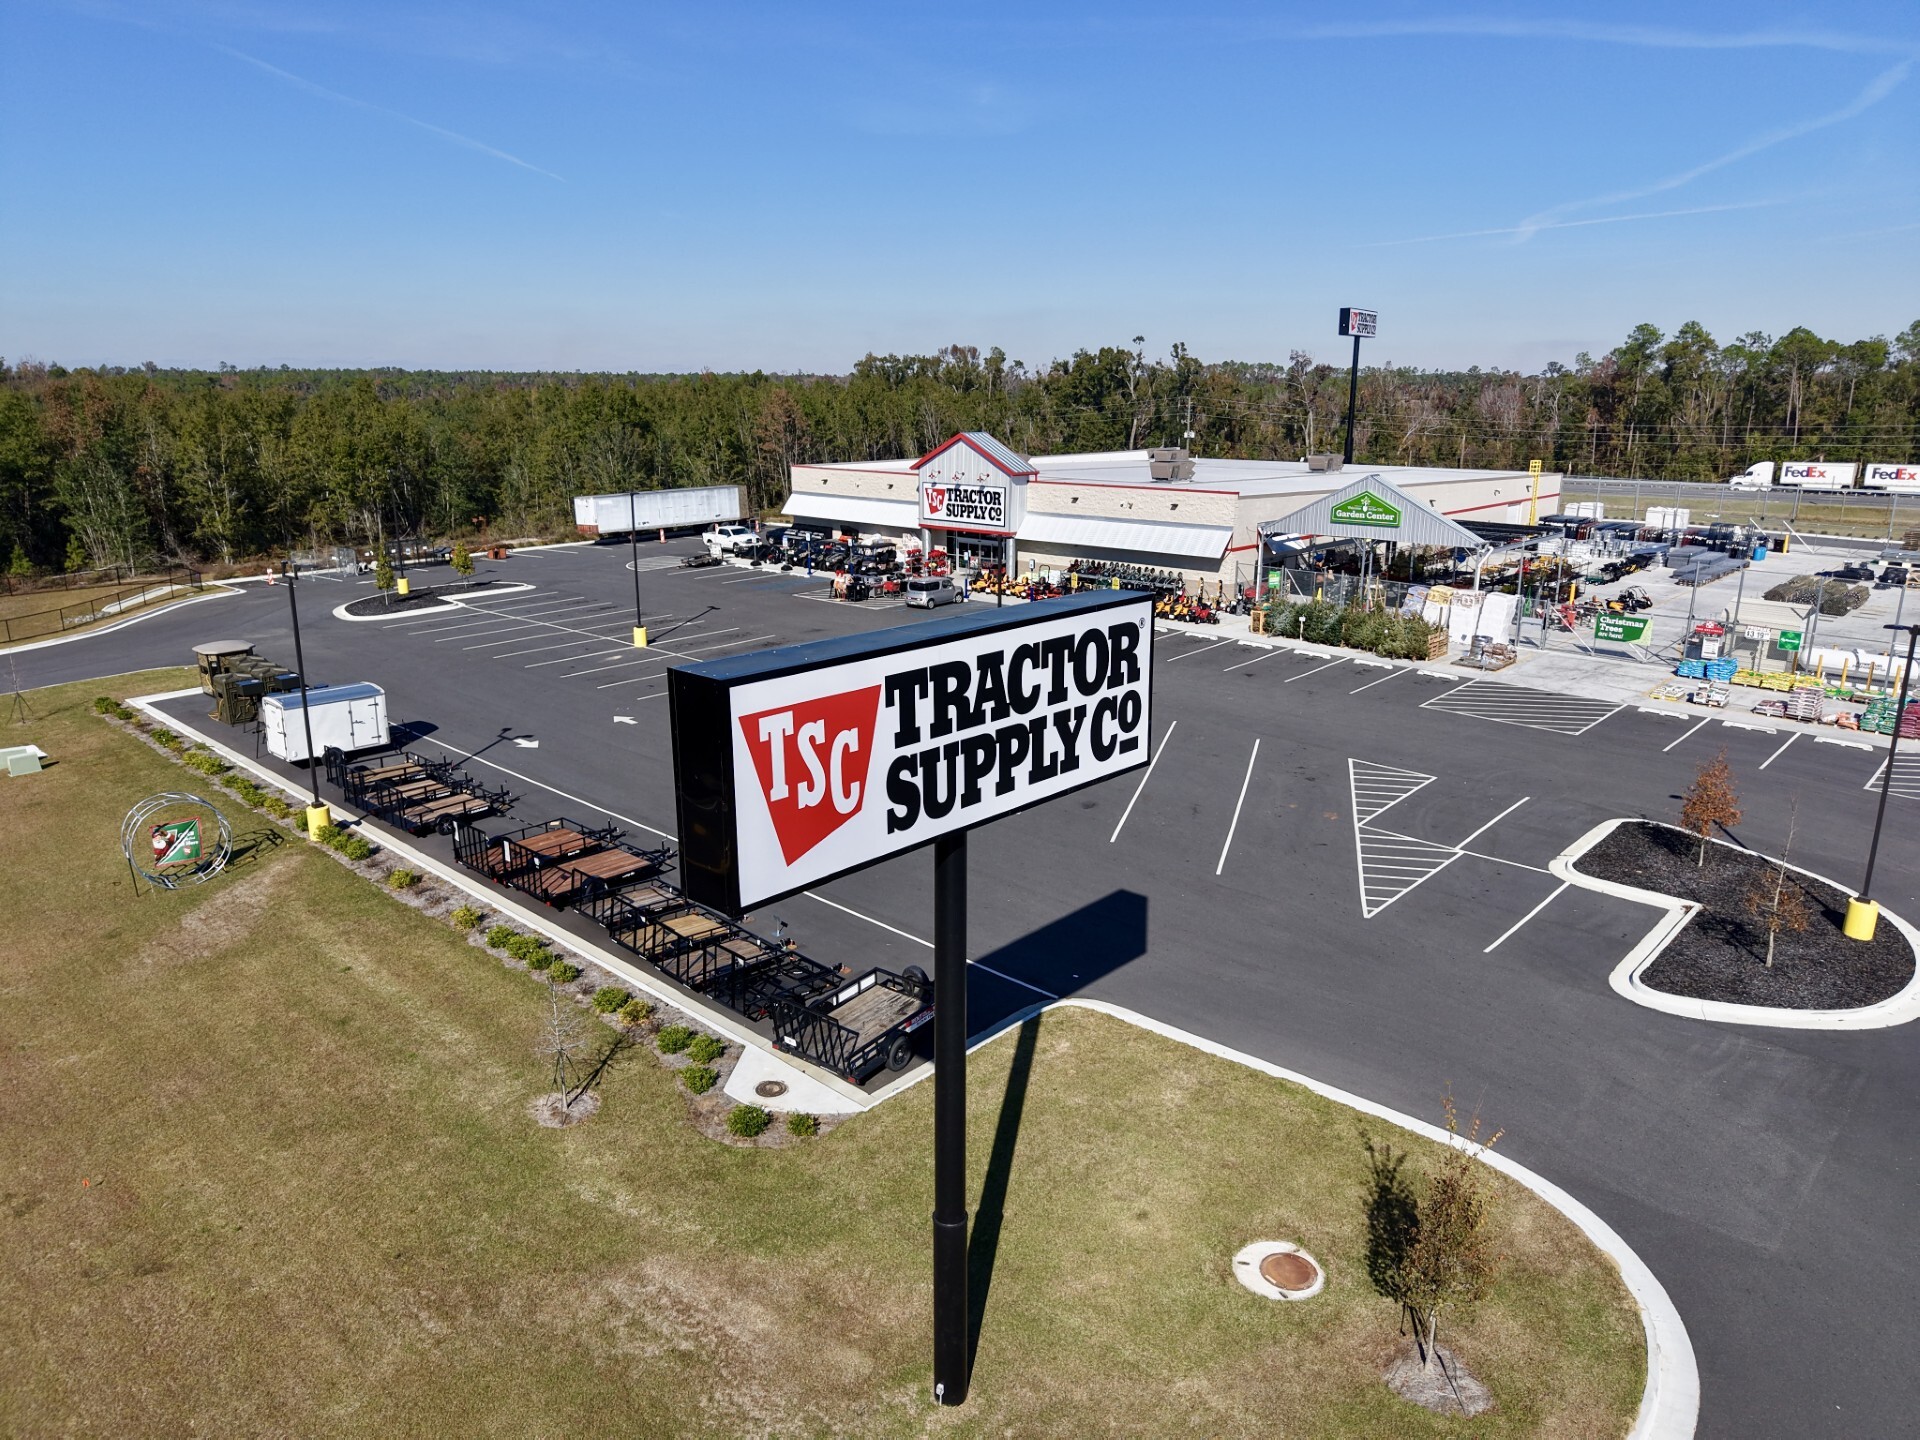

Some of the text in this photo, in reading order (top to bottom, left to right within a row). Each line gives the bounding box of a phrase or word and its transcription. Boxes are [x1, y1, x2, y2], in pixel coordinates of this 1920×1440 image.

[1784, 466, 1827, 478] FedEx
[1871, 467, 1917, 481] FedEx
[927, 489, 943, 511] TSC
[946, 488, 1002, 506] TRACTOR
[946, 503, 988, 520] SUPPLY
[1336, 509, 1395, 521] Garden Center
[1599, 623, 1623, 633] Trees
[1600, 616, 1644, 628] Christmas
[885, 621, 1141, 749] TRACTOR
[758, 710, 861, 815] TSC
[886, 704, 1087, 834] SUPPLY
